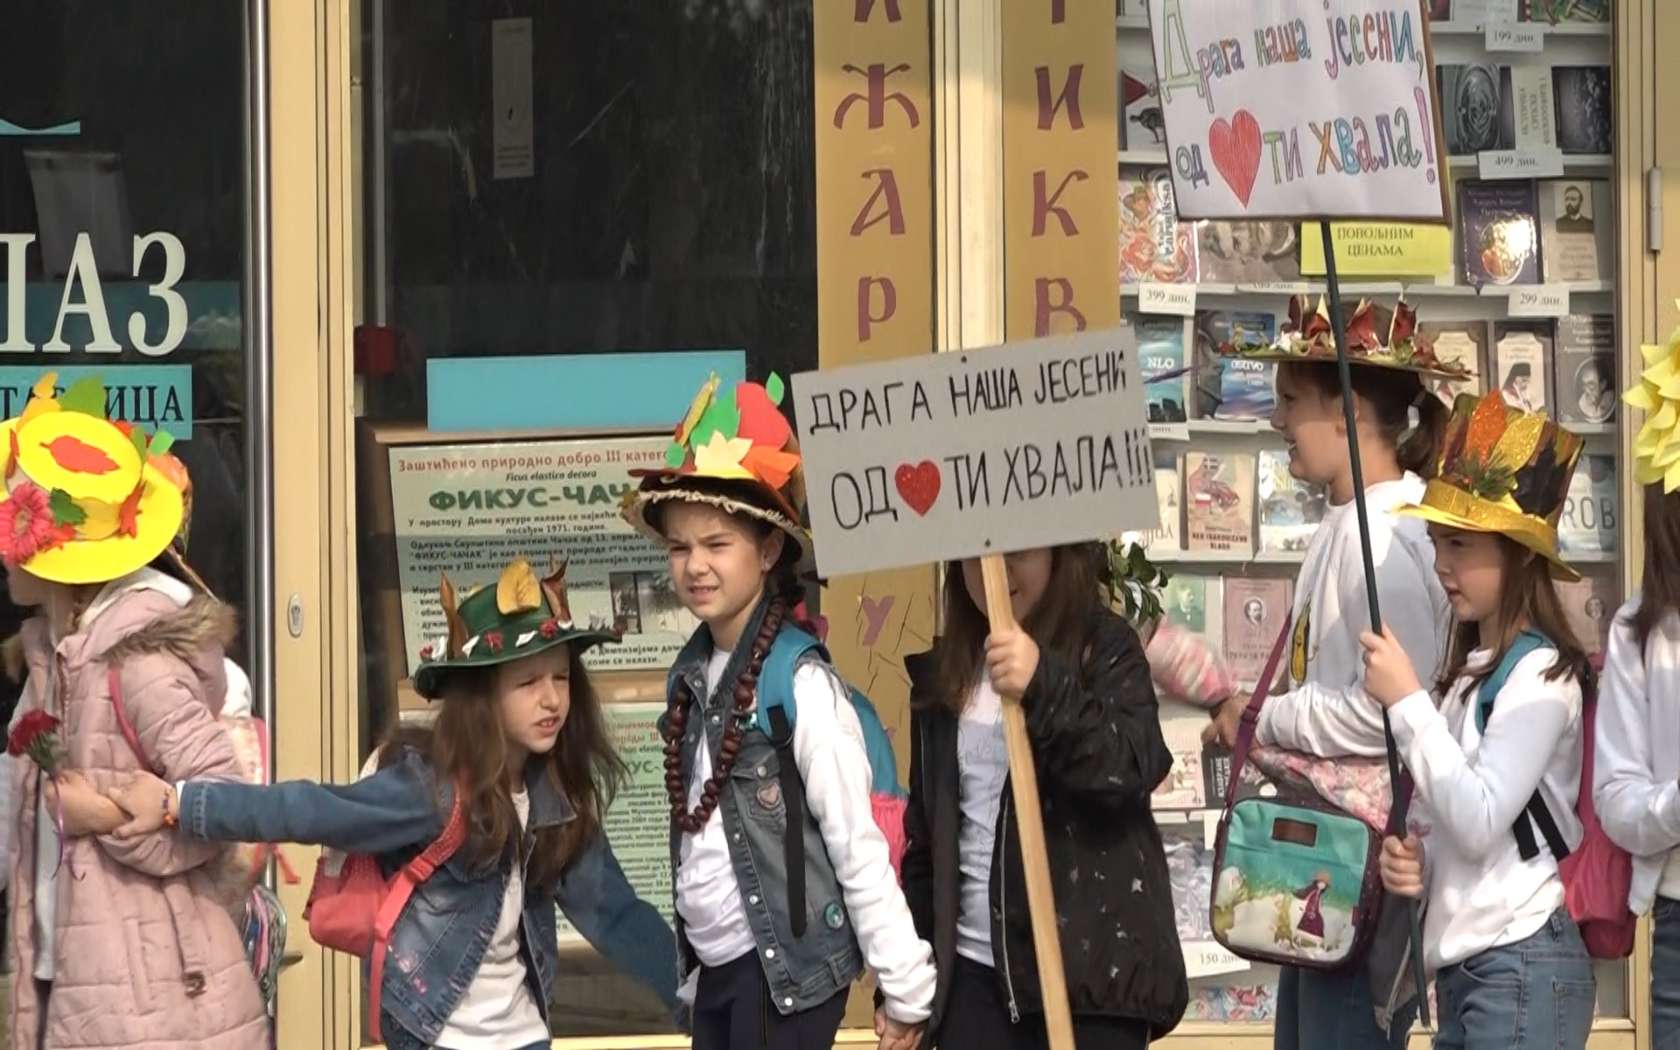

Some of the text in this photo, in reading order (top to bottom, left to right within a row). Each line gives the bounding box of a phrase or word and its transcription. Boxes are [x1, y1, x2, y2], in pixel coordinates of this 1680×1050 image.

[1254, 18, 1312, 67] наша
[1336, 226, 1415, 241] ПОВОЉНИМ
[1347, 243, 1405, 258] ЦЕНАМА
[1146, 356, 1175, 370] NLO
[809, 350, 1128, 435] ДРАГА НАША ЈЕСЕНИ
[399, 458, 477, 473] Заштићено
[481, 456, 553, 471] природно
[558, 451, 601, 467] добро
[831, 465, 899, 530] ОД
[943, 451, 991, 511] ТИ
